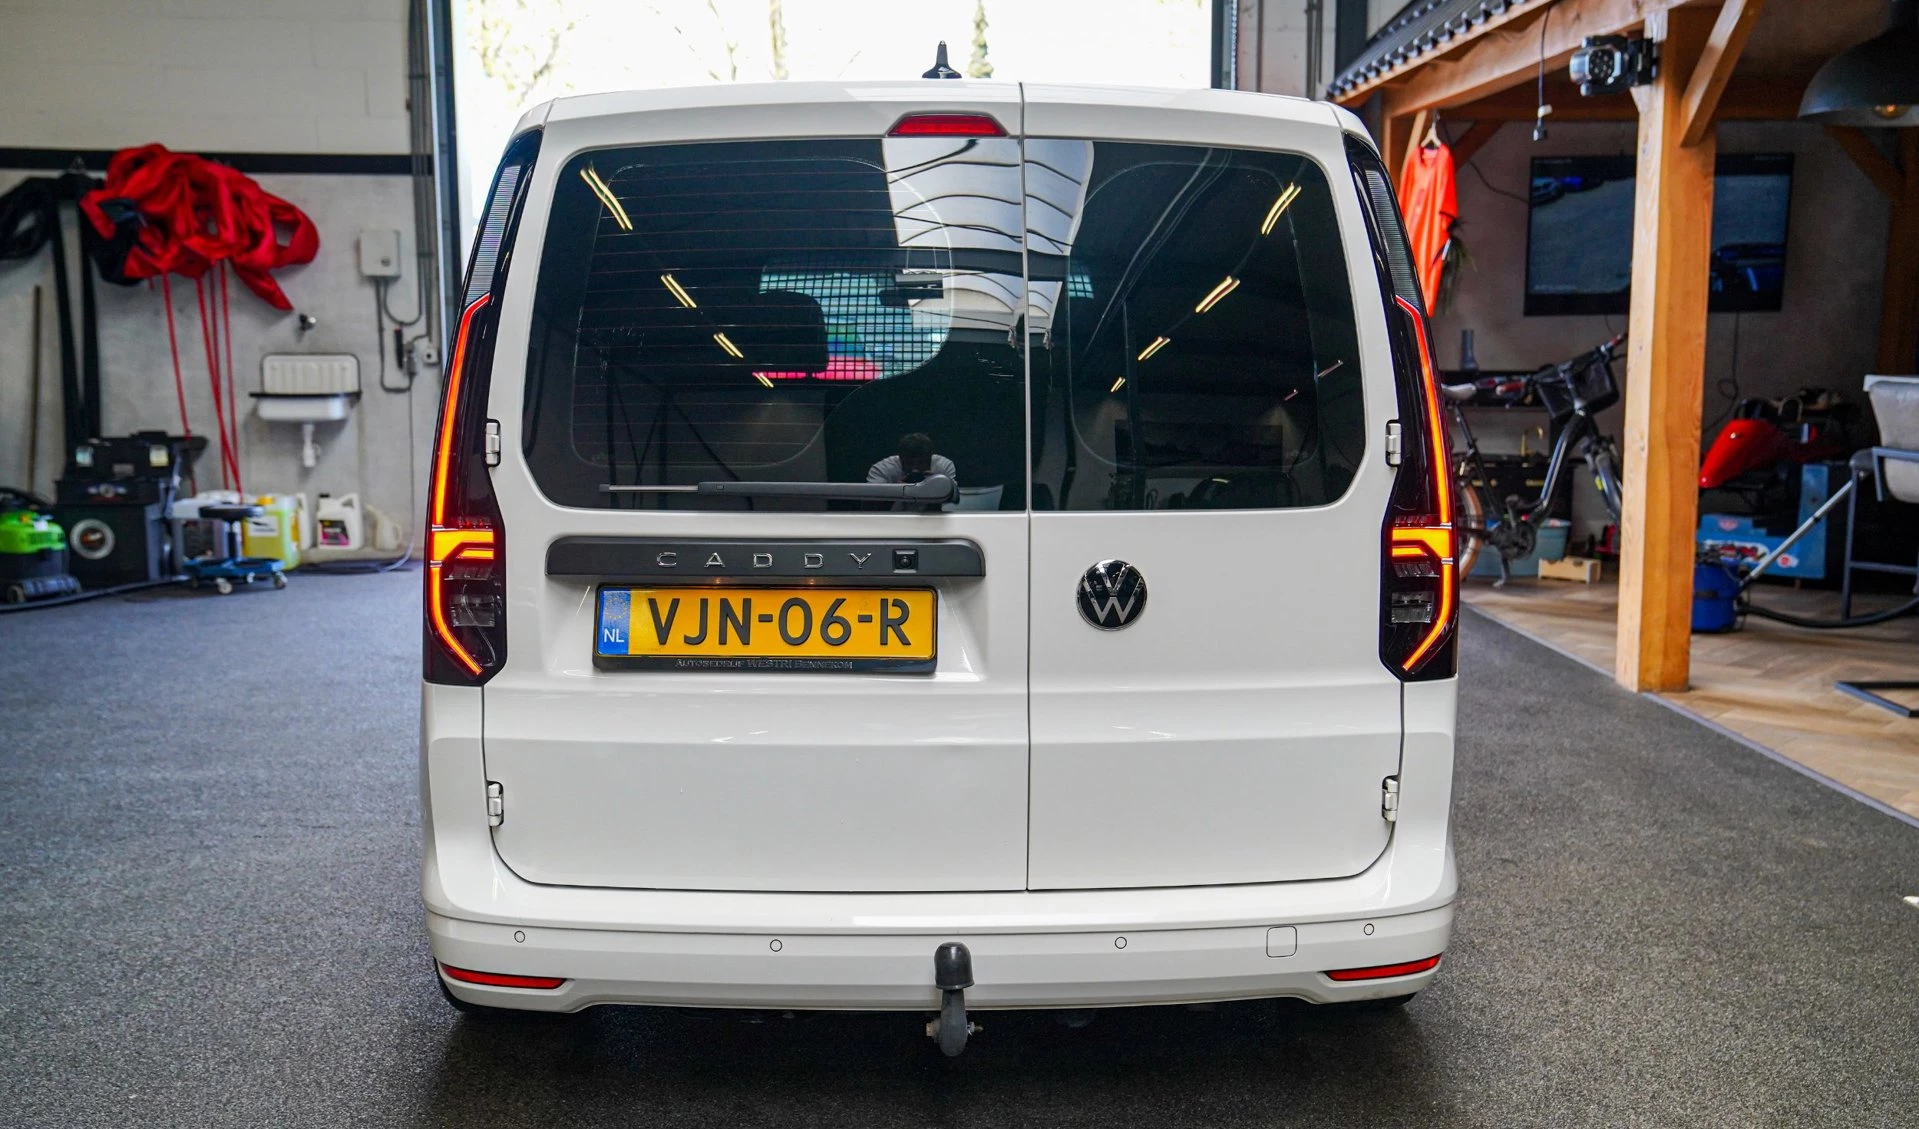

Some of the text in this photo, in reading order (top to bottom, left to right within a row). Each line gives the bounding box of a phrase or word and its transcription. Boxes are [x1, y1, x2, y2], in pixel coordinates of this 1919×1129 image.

[656, 551, 872, 569] CADDY
[648, 597, 912, 647] VJN-06-R
[603, 628, 625, 643] NL
